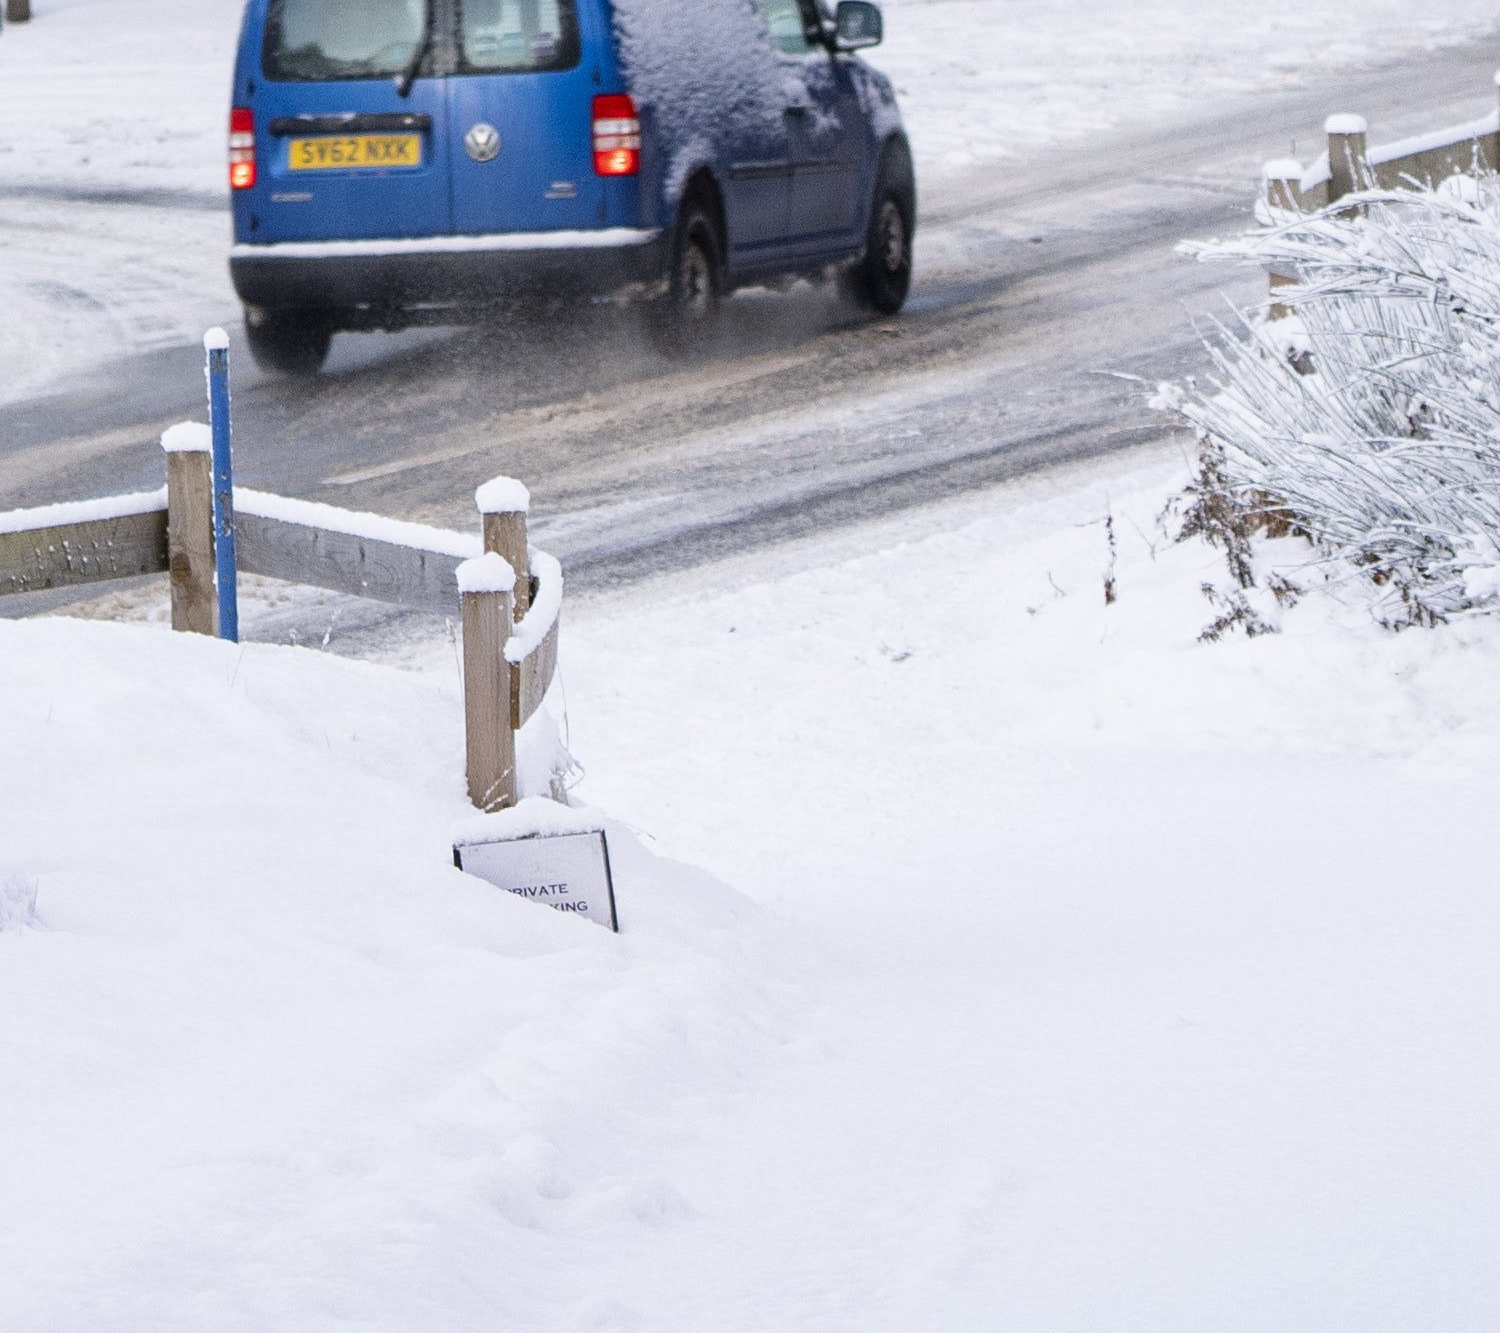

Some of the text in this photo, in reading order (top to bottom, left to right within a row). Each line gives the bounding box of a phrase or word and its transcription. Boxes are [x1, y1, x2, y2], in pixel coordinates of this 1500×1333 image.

[302, 137, 411, 164] SV62 NXK
[508, 883, 569, 897] RIVATE
